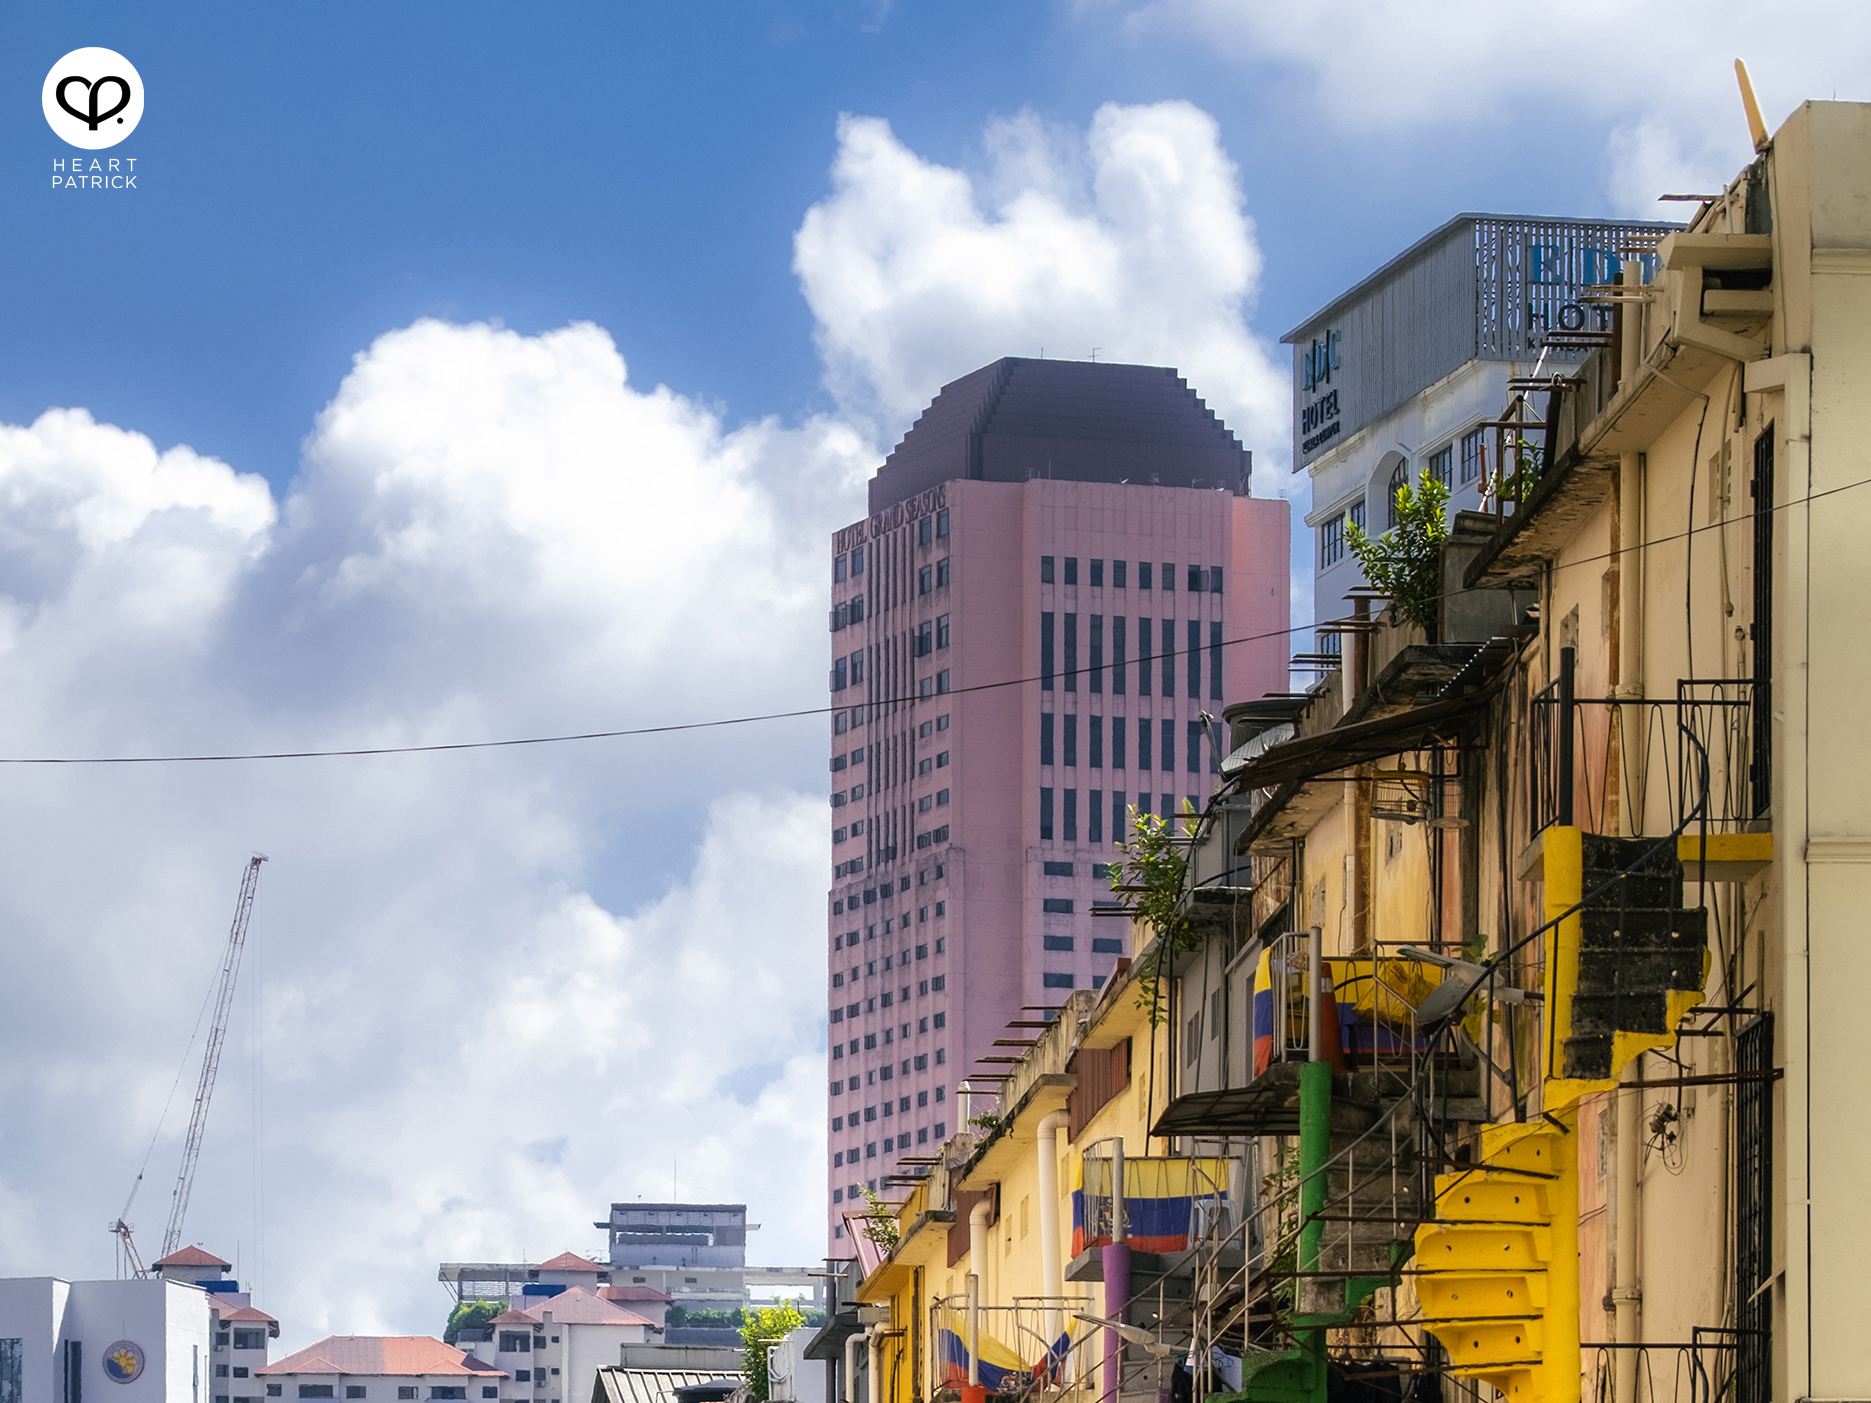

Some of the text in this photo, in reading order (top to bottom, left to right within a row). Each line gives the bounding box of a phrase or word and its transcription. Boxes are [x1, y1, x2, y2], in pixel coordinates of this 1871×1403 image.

[1302, 389, 1340, 435] HOTEL
[837, 484, 947, 554] HOTEL GRAND SEASONS
